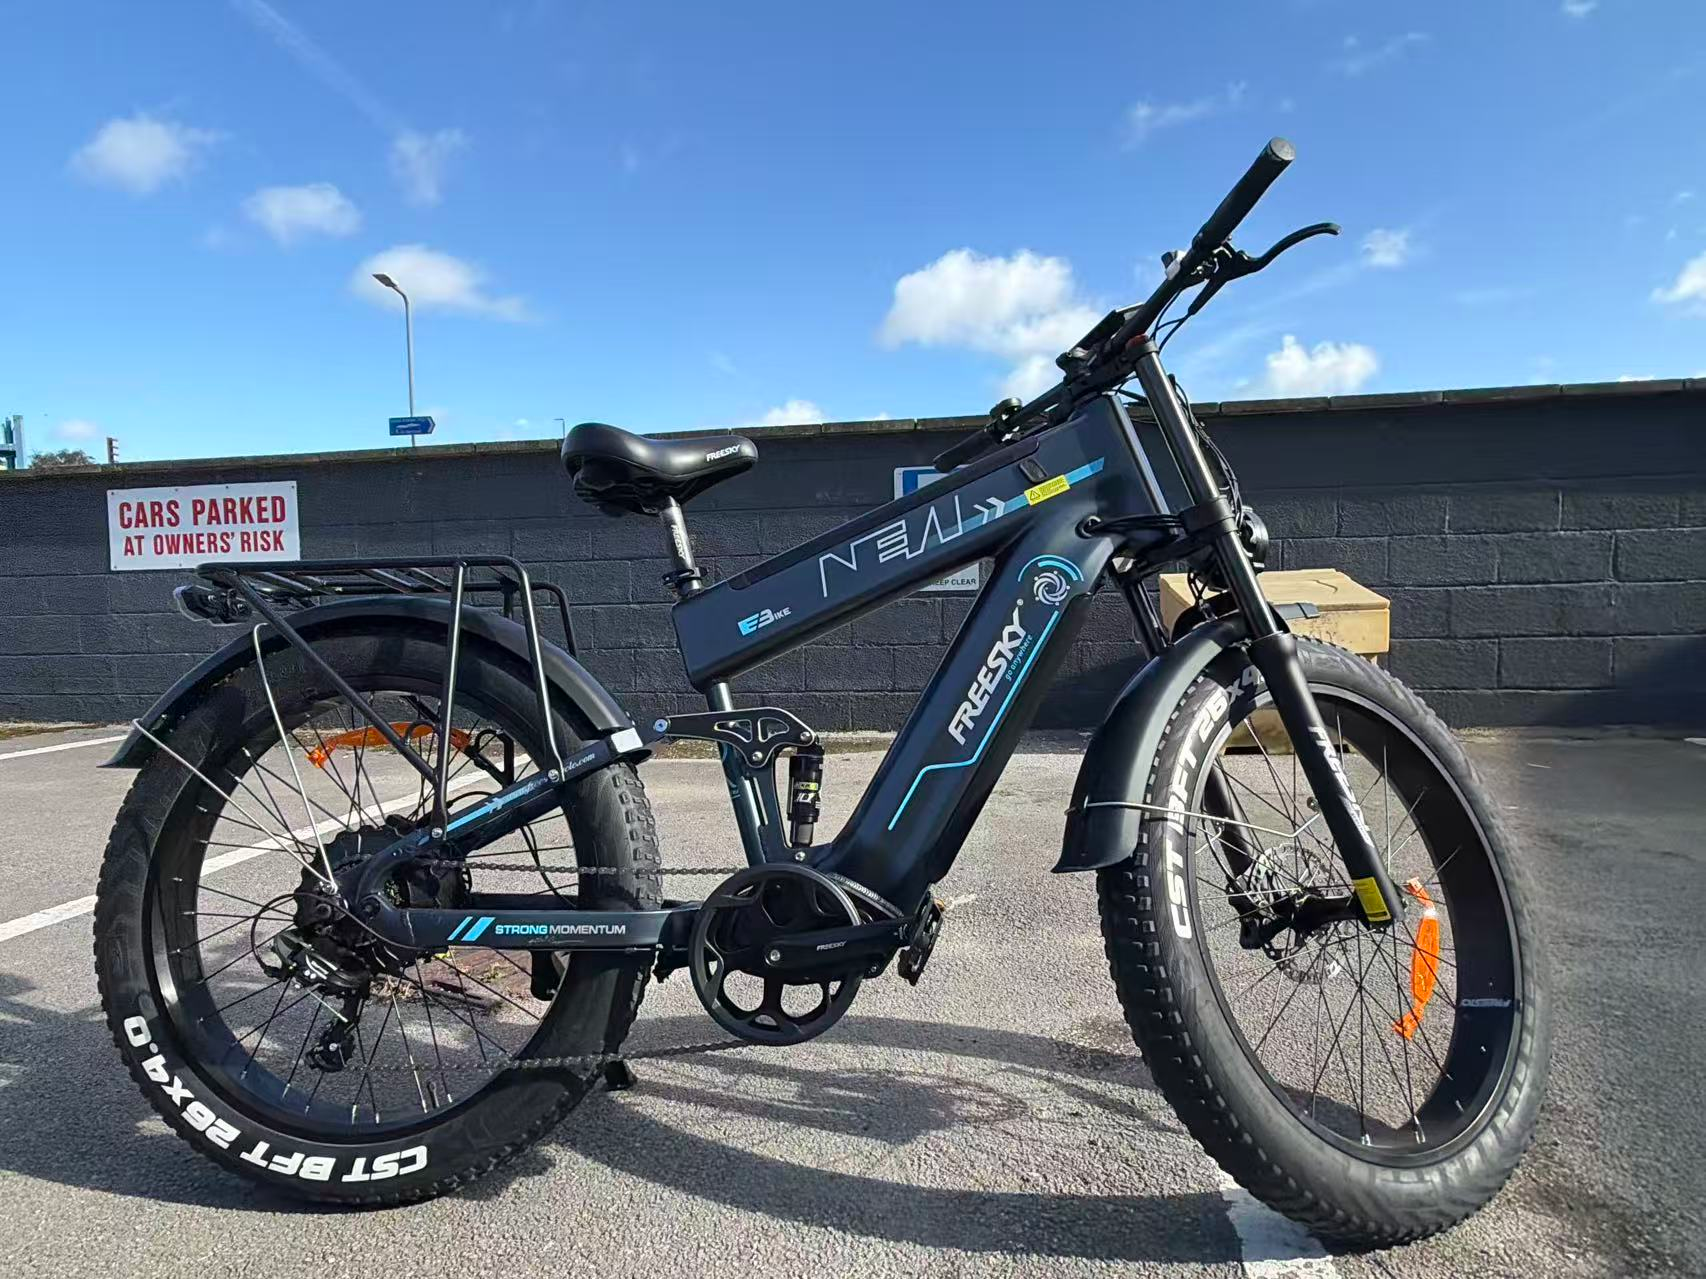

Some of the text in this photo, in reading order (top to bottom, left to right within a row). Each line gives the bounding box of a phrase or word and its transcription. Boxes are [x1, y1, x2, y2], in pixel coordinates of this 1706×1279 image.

[706, 444, 741, 462] FREESKY
[119, 495, 287, 529] CARS PARKED
[124, 530, 285, 556] AT OWNERS' RISK
[951, 578, 977, 586] CLEAR
[948, 606, 1027, 746] FREESKY
[1005, 634, 1034, 682] go anywhere
[1167, 728, 1200, 836] BFT
[1166, 839, 1193, 940] CST
[495, 924, 626, 935] STRONG MOMENTUM
[240, 1141, 337, 1182] BFT
[341, 1145, 428, 1183] CST
